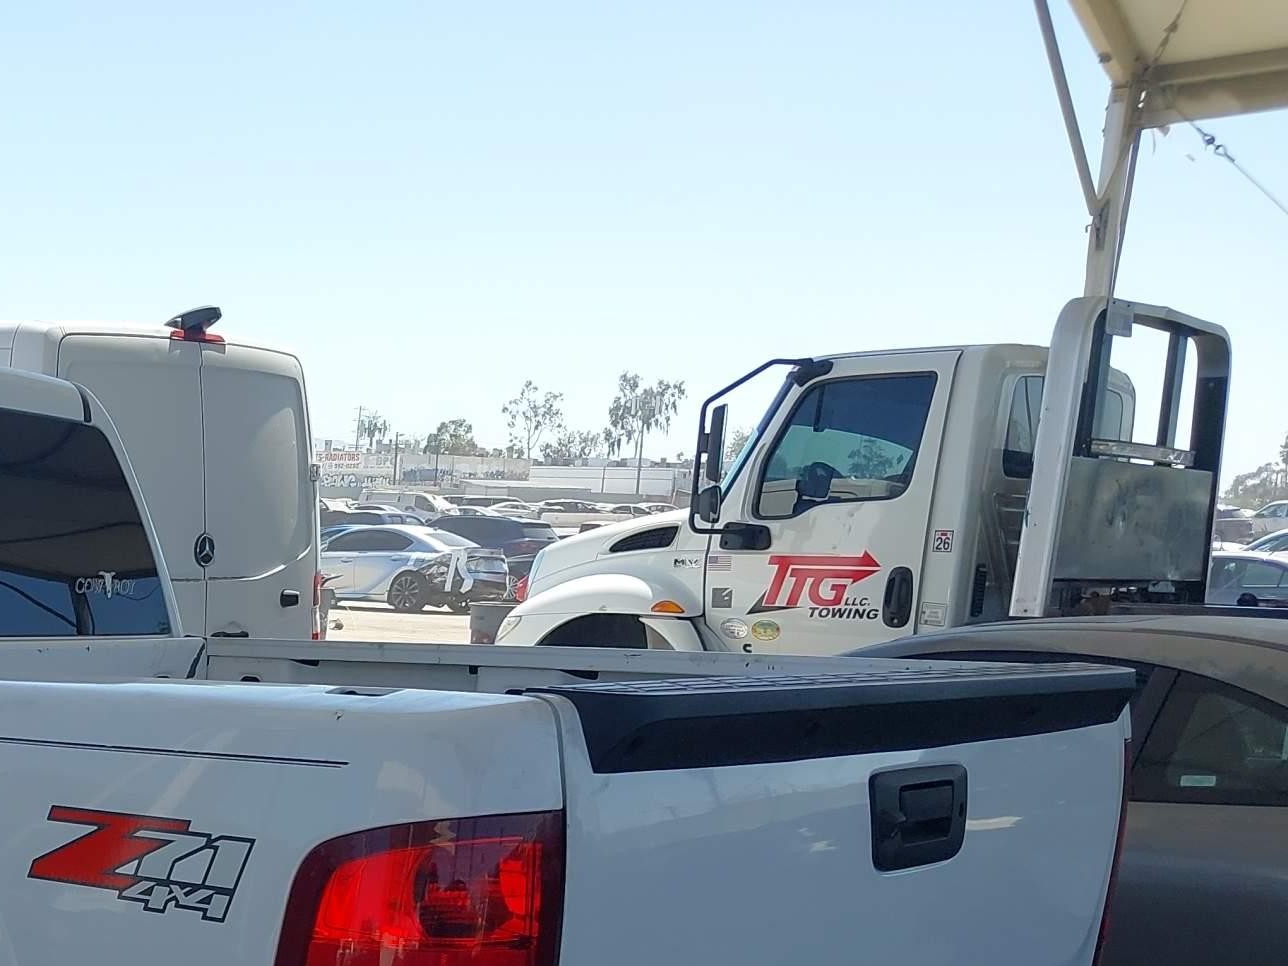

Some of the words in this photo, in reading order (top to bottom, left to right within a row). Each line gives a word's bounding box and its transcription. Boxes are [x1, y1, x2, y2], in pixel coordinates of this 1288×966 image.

[935, 536, 951, 551] 26
[808, 607, 879, 620] TOWING
[27, 804, 257, 892] Z71
